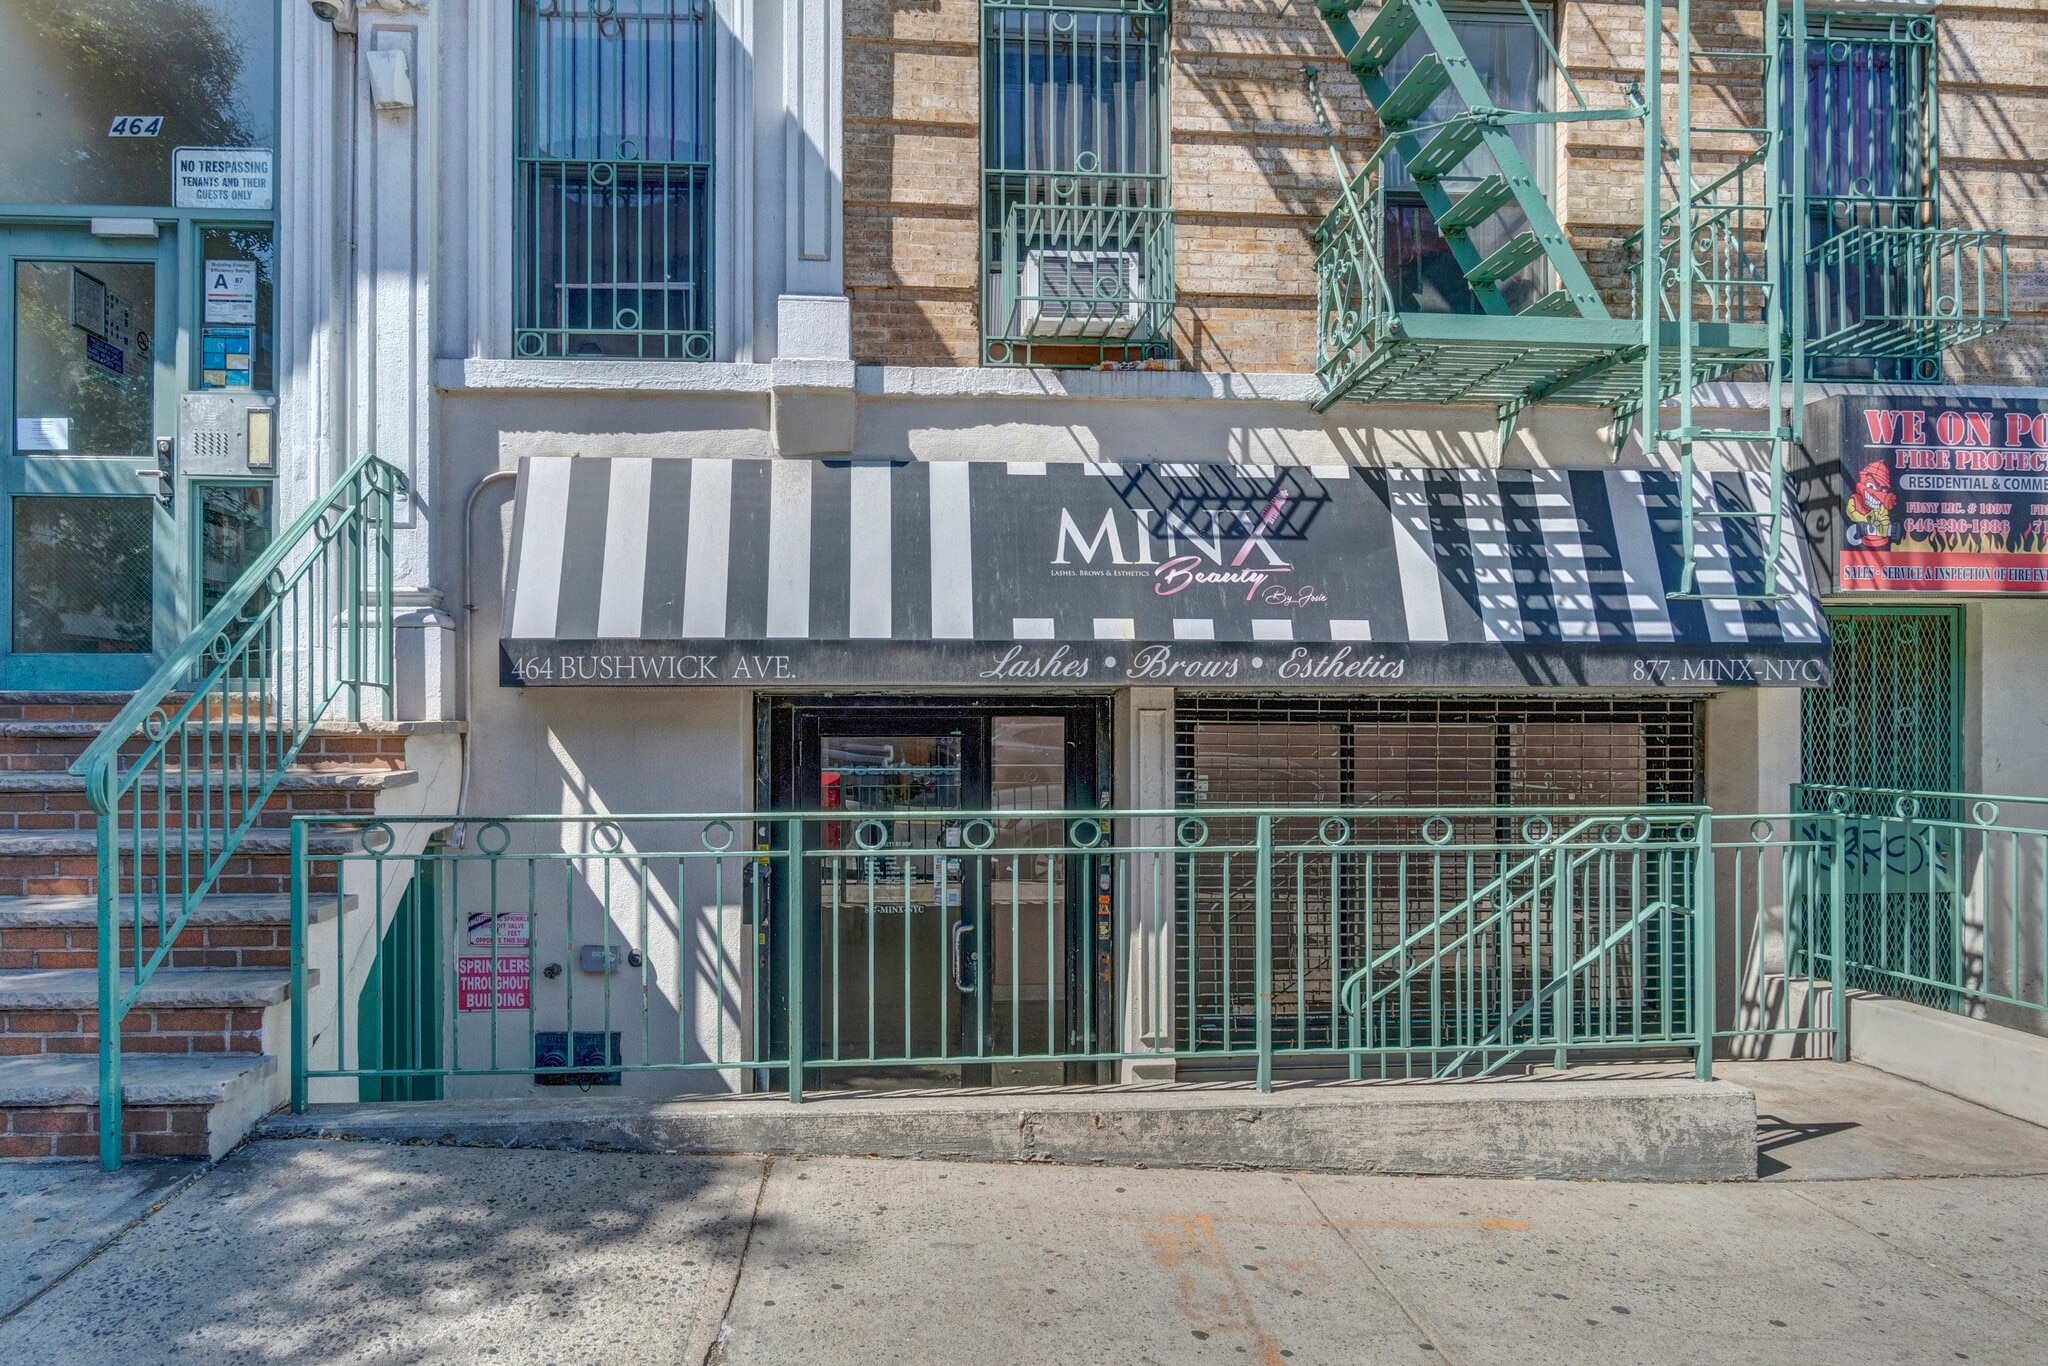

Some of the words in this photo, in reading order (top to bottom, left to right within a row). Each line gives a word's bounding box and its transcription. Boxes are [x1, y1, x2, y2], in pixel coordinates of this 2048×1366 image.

[112, 117, 161, 136] 464
[180, 160, 195, 173] NO
[199, 160, 268, 174] TRESPASSING
[182, 176, 219, 187] TENANTS
[222, 177, 239, 188] AND
[242, 177, 266, 188] THEIR
[196, 189, 229, 200] GUESTS
[231, 190, 252, 200] ONLY
[213, 273, 229, 289] A
[1863, 409, 1926, 444] WE
[1936, 411, 1993, 446] ON
[1895, 450, 1950, 469] FIRE
[1908, 476, 1988, 490] RESIDENTIAL
[1991, 477, 2001, 490] &
[1905, 501, 1939, 514] FDNY
[1940, 502, 1966, 515] LIC.
[1979, 503, 2013, 516] 198W
[1903, 517, 2011, 534] 646-296-1986
[1050, 505, 1291, 567] MINX
[1079, 569, 1105, 577] BROWS
[1106, 569, 1112, 577] &
[1113, 569, 1150, 577] ESTHETICS
[1154, 555, 1291, 601] Beauty
[1844, 565, 1874, 581] SALES
[1881, 566, 1923, 581] SERVICE
[1924, 566, 1932, 581] &
[1934, 566, 1992, 582] INSPECTION
[1993, 567, 2006, 582] OF
[2007, 567, 2031, 582] FIRE
[2032, 568, 2048, 582] EX
[1261, 585, 1297, 606] By
[511, 656, 553, 680] 464
[559, 655, 718, 680] BUSHWICK
[731, 655, 797, 680] AVE.
[979, 643, 1089, 679] Lashes
[1126, 644, 1239, 679] Brows
[1277, 646, 1406, 679] Esthetics
[1681, 658, 1822, 682] MINX-NYC
[864, 905, 925, 914] 87-MINX-NYC
